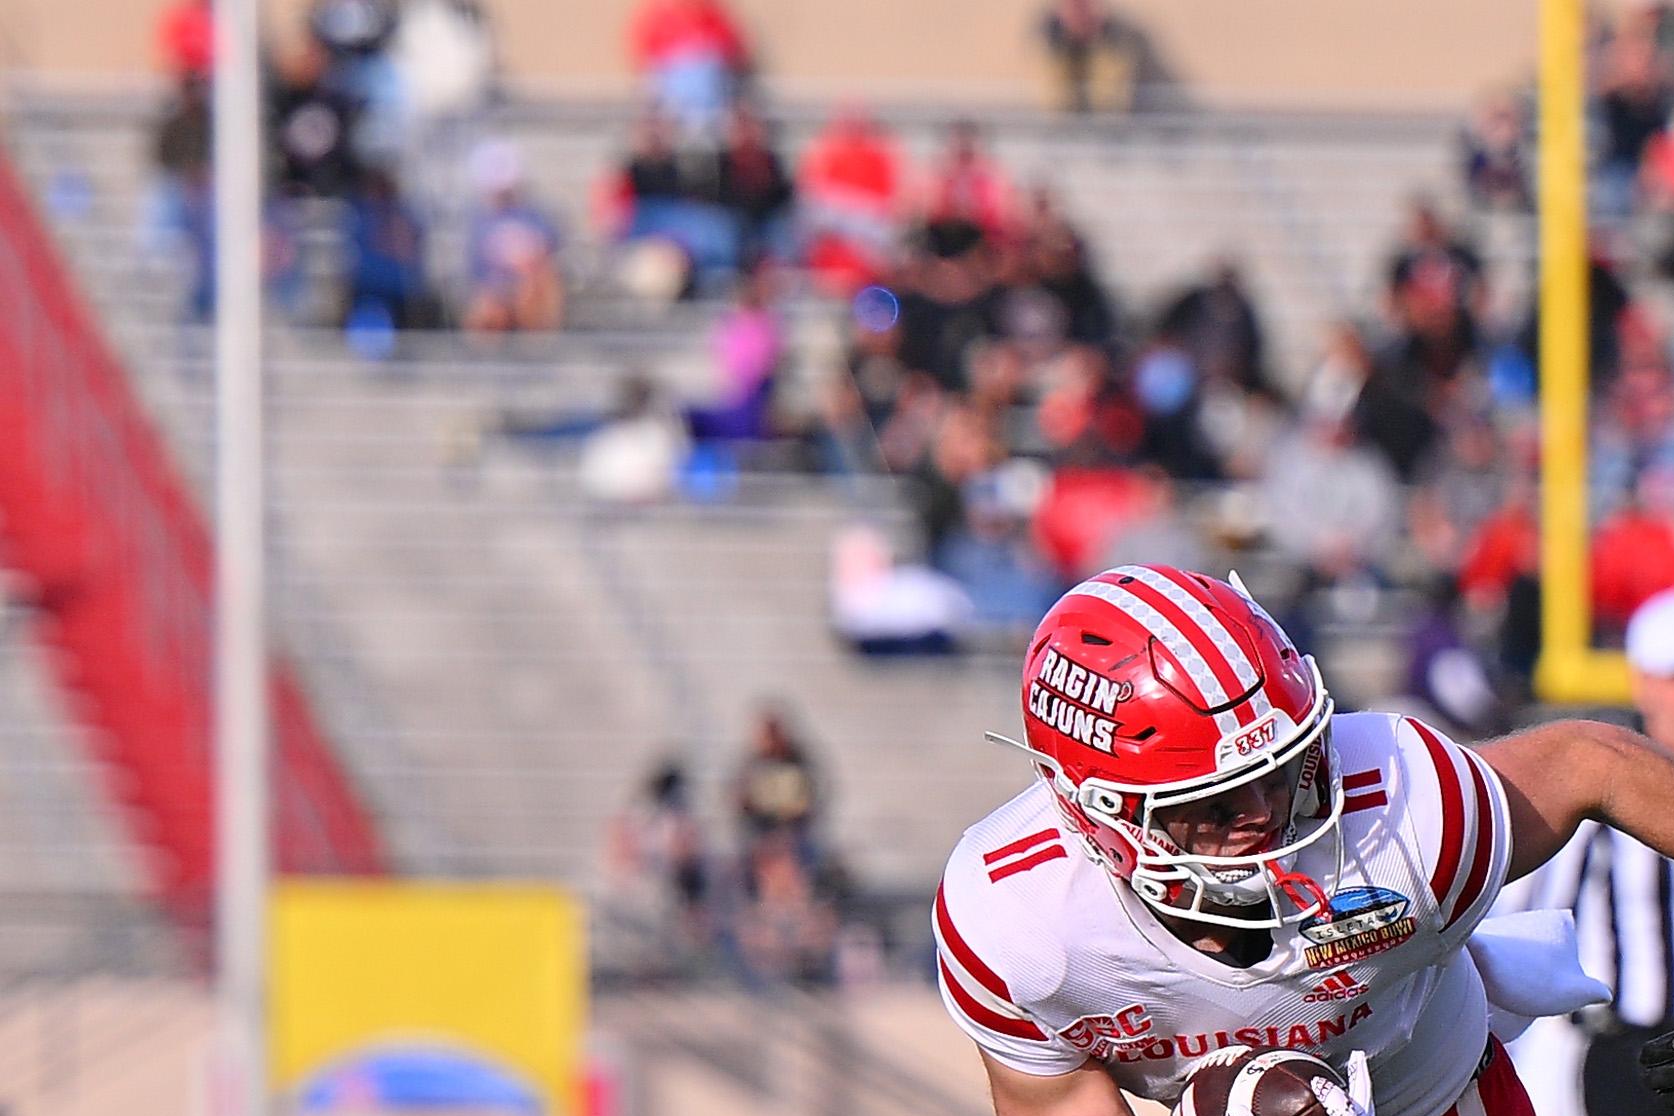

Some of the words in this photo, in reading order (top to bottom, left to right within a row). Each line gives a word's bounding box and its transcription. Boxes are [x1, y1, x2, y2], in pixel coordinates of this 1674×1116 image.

[1028, 680, 1118, 756] CAJUNS
[1235, 718, 1277, 756] 337
[982, 827, 1068, 884] 11
[1314, 915, 1376, 940] ISLETA
[1303, 984, 1370, 1003] adidas
[1113, 1001, 1374, 1064] LOUISIANA
